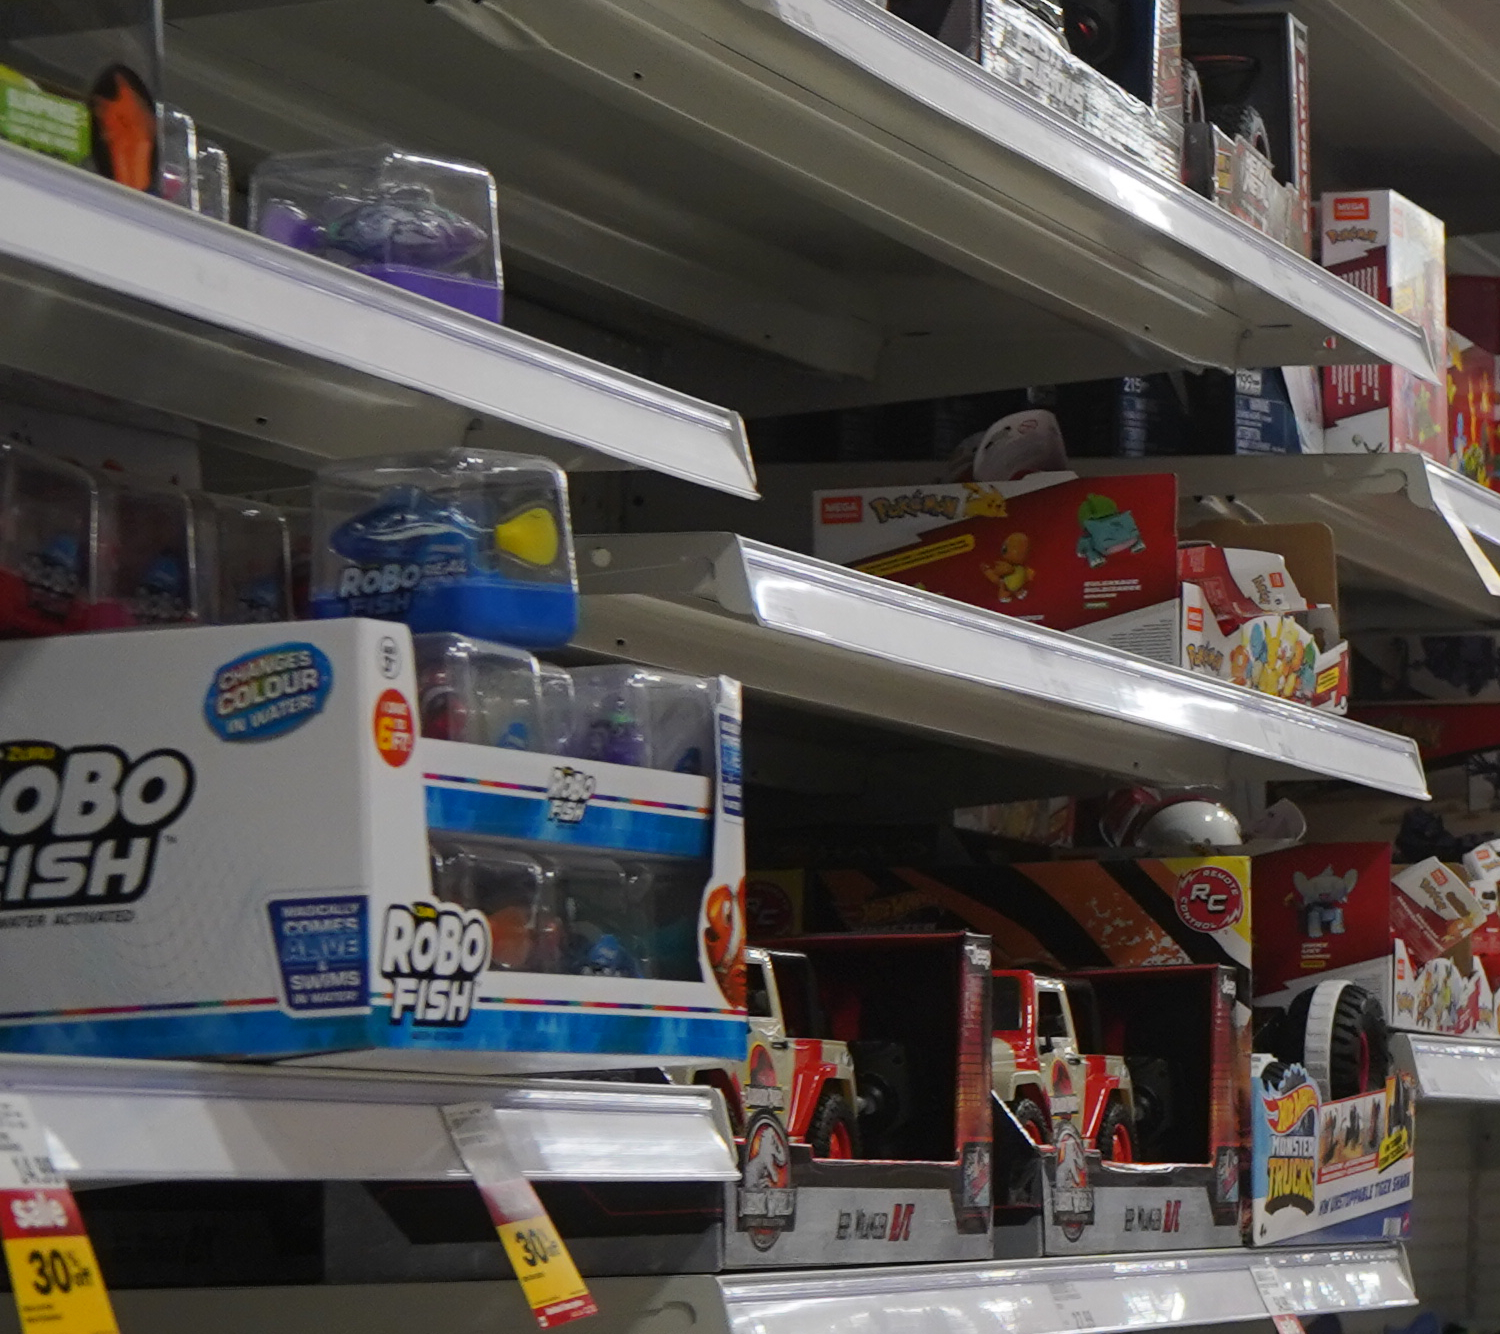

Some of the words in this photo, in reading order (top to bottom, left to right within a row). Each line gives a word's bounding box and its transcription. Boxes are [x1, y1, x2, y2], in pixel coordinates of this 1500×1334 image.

[822, 501, 860, 517] MEGA
[340, 566, 421, 596] ROBO
[218, 651, 314, 691] CHANGES
[216, 668, 320, 718] COLOUR
[225, 717, 248, 735] IN
[250, 694, 316, 729] WATER!
[0, 750, 189, 836] OBO
[548, 769, 595, 799] ROBO
[549, 797, 588, 823] FISH
[1189, 882, 1229, 909] RC
[1202, 867, 1240, 896] REMOTE
[282, 903, 360, 917] MAGICALLY
[1179, 900, 1236, 933] CONTROL
[283, 917, 359, 936] COMES
[381, 907, 487, 975] ROBO
[285, 938, 359, 962] ALIVE
[967, 943, 992, 968] Jeep
[288, 973, 361, 990] SWIMS
[390, 974, 473, 1024] FISH
[1271, 1135, 1315, 1156] MONSTER
[1268, 1157, 1315, 1200] TRUCKS
[1330, 1184, 1374, 1215] UNSTOPPABLE
[1374, 1178, 1392, 1197] TIGER
[1392, 1171, 1411, 1193] SHARK
[10, 1197, 67, 1230] sale
[73, 1265, 94, 1287] off
